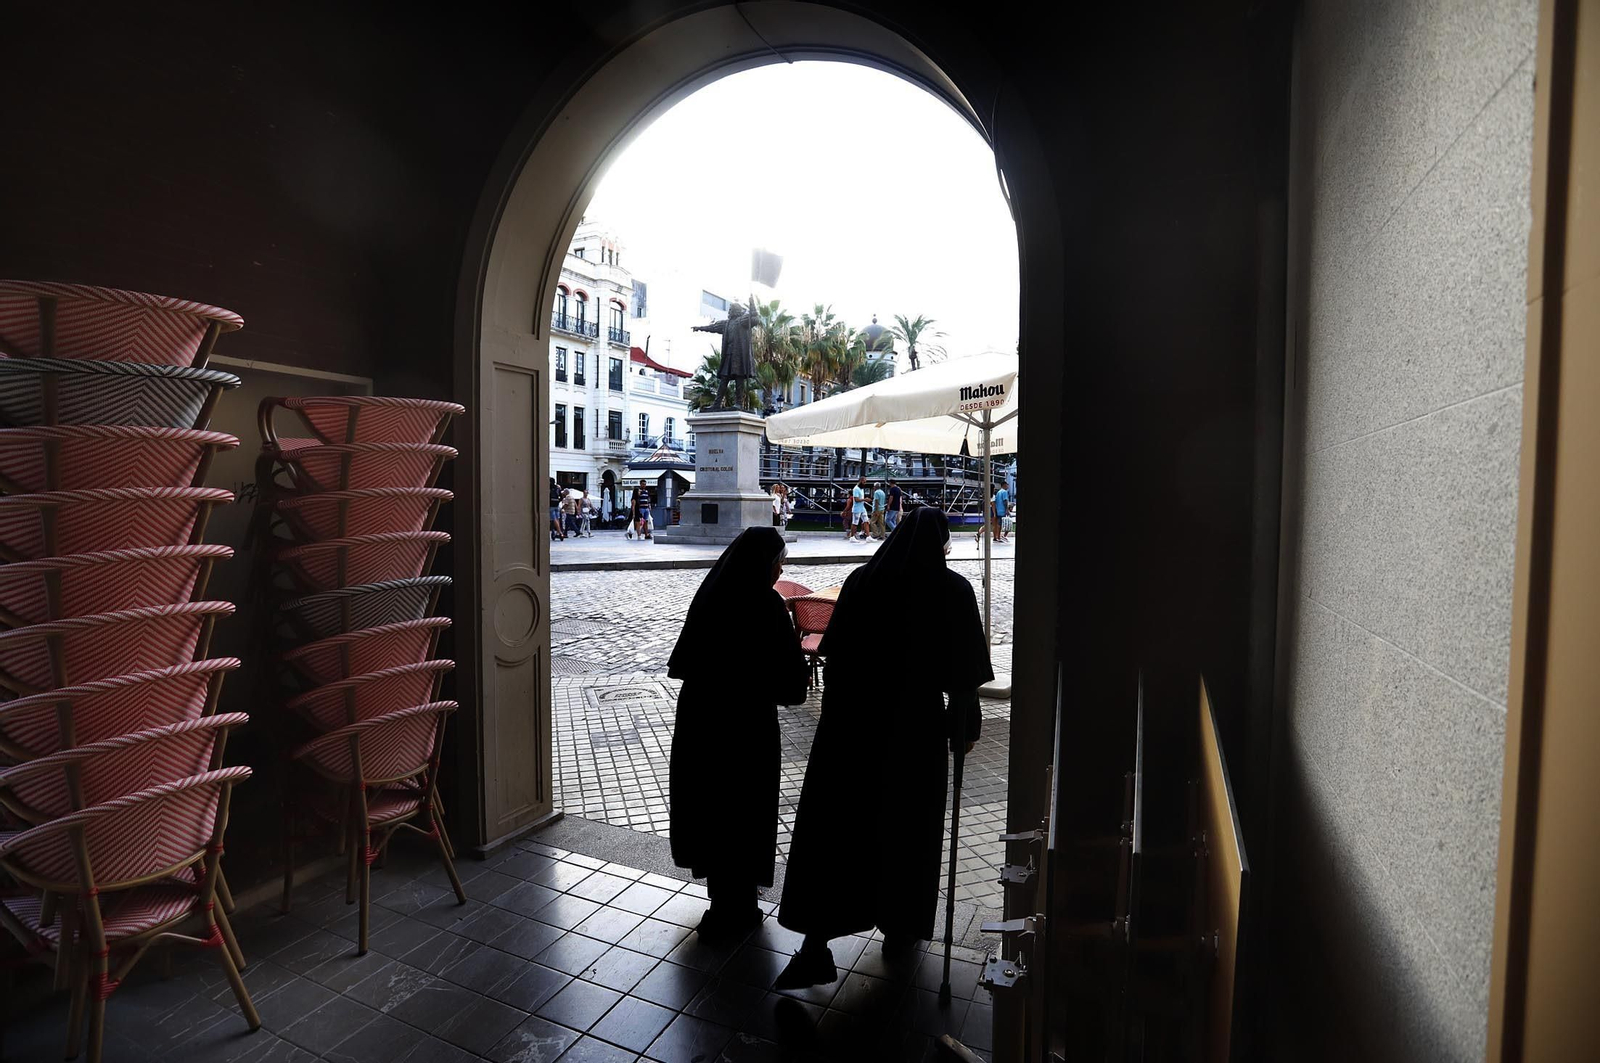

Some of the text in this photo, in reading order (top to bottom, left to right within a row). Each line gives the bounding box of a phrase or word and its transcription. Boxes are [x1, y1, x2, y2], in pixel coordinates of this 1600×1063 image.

[960, 384, 1005, 401] Mahou
[960, 399, 1005, 411] DESDE 1890
